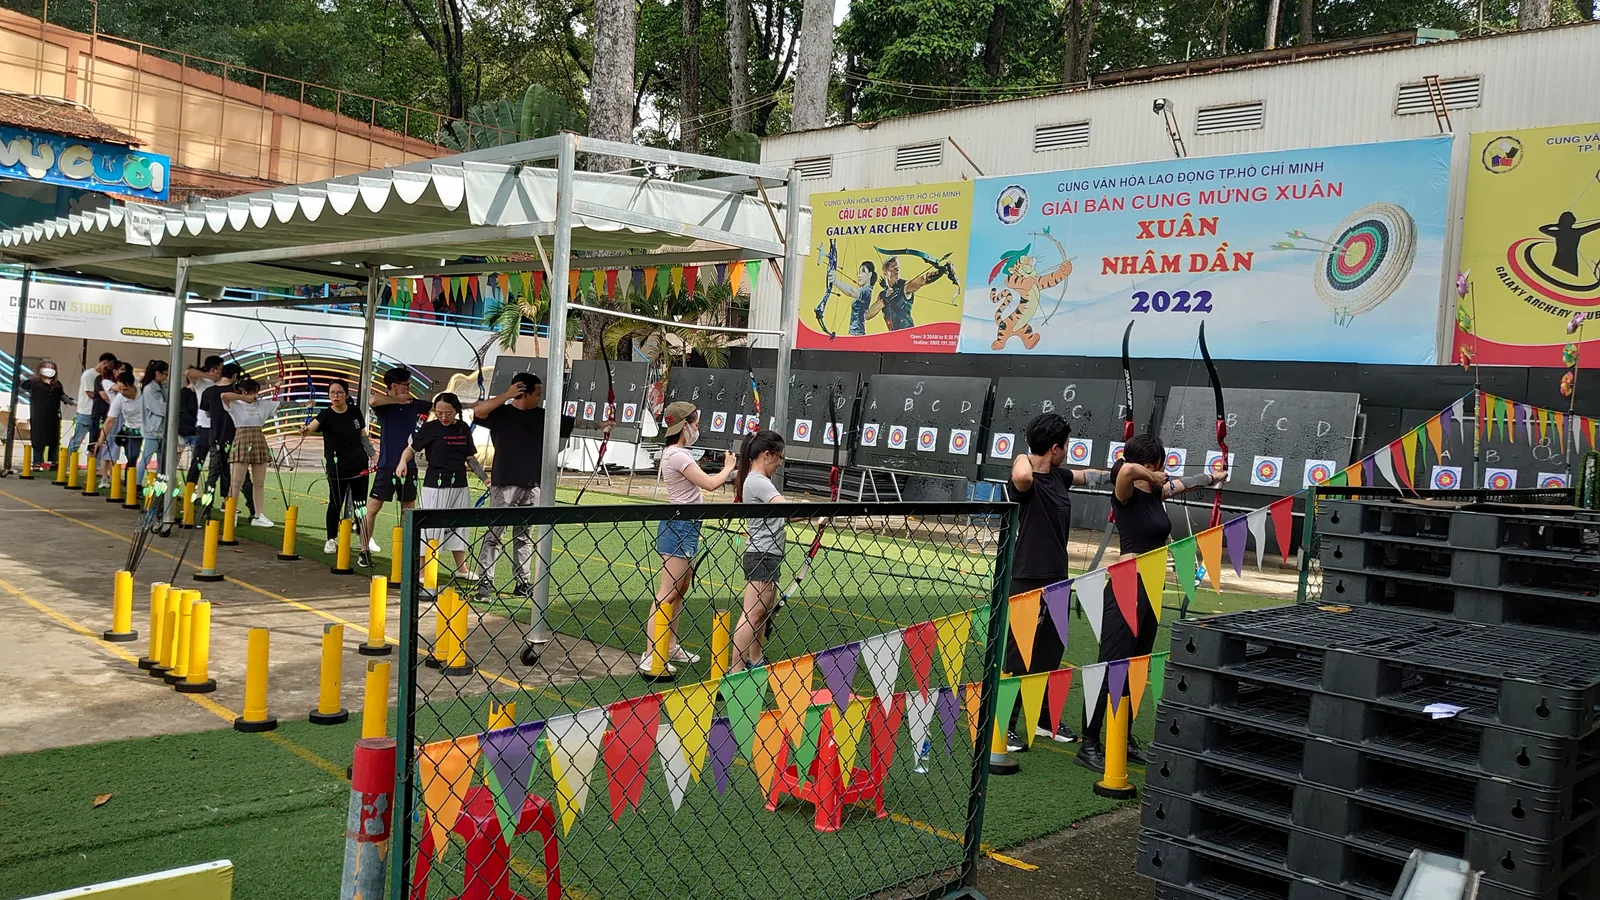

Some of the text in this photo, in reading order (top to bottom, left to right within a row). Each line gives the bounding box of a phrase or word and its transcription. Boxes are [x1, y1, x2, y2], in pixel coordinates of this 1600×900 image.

[1546, 135, 1580, 145] CUNG
[1057, 181, 1089, 193] CUNG
[1093, 177, 1116, 189] VĂN
[1120, 174, 1145, 187] HÓA
[1148, 173, 1174, 185] LAO
[1261, 162, 1285, 177] CHÍ
[1288, 161, 1325, 175] MINH
[942, 190, 961, 198] MINH
[1131, 191, 1191, 210] CUNG
[1198, 185, 1269, 206] MỪNG
[1275, 179, 1344, 201] XUÂN
[857, 208, 873, 222] LẠC
[876, 205, 889, 220] BỘ
[913, 203, 939, 216] CUNG
[826, 220, 958, 236] GALAXY ARCHERY CLUB
[1136, 212, 1220, 240] XUÂN
[1101, 249, 1182, 275] NHÂM
[1130, 290, 1213, 314] 2022
[1495, 266, 1527, 297] GALAXY
[1523, 295, 1573, 319] ARCHERY
[9, 296, 45, 310] CCK
[49, 300, 66, 311] ON
[70, 301, 113, 315] STUDIO
[707, 374, 715, 387] 3
[913, 381, 925, 396] 5
[1062, 383, 1077, 402] 6
[904, 398, 914, 412] B
[931, 399, 941, 412] C
[960, 400, 972, 414] D
[1004, 397, 1015, 409] A
[1042, 399, 1055, 414] B
[1071, 404, 1083, 419] C
[1261, 398, 1275, 421] 7
[1174, 413, 1331, 438] A B C D
[1441, 449, 1451, 461] A
[1485, 449, 1500, 464] B
